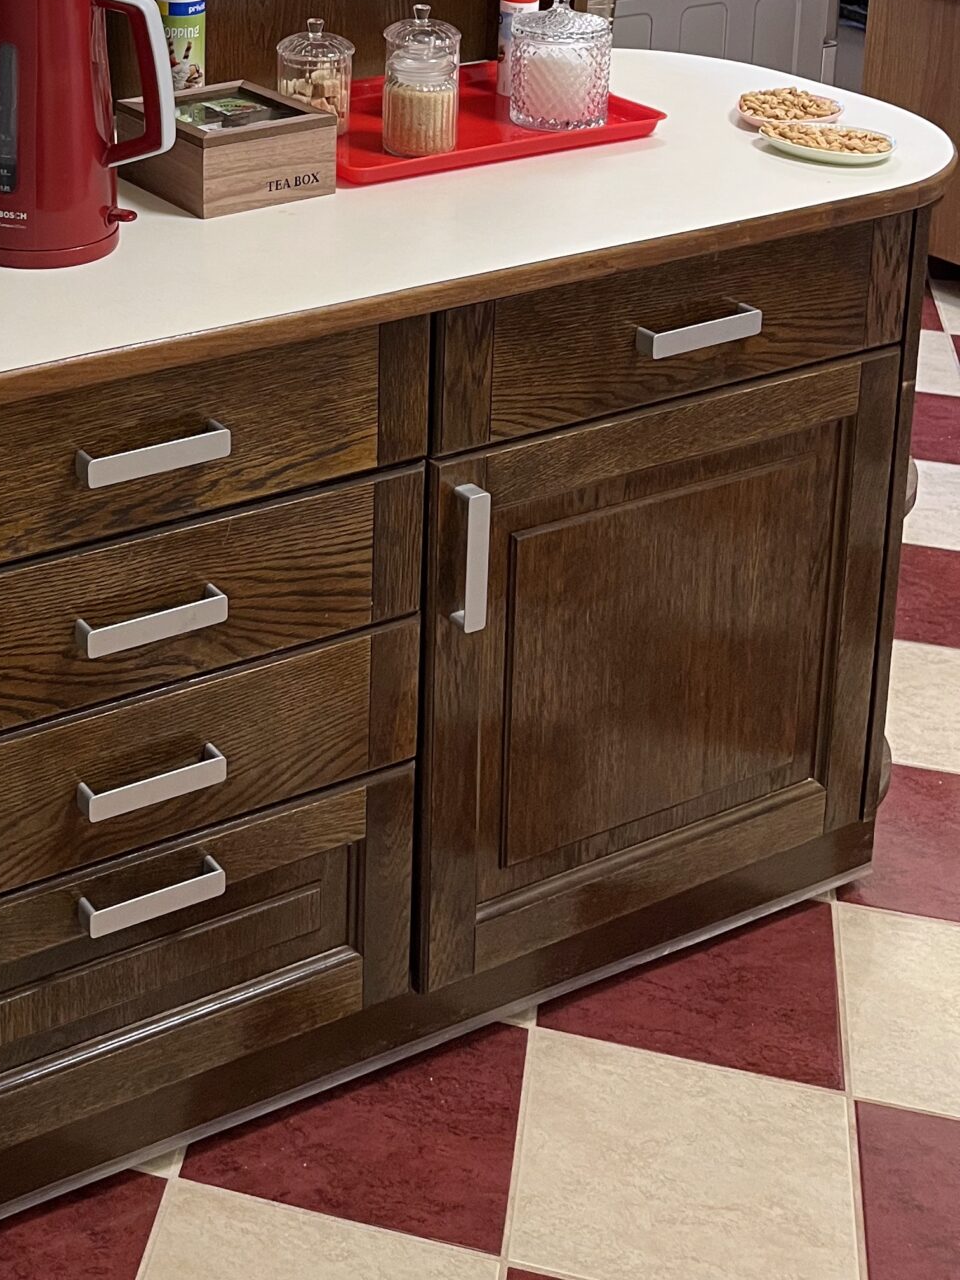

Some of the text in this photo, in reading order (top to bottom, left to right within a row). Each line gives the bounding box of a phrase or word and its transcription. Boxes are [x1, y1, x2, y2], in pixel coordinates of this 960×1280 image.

[162, 25, 200, 39] opping
[266, 170, 321, 192] TEA BOX
